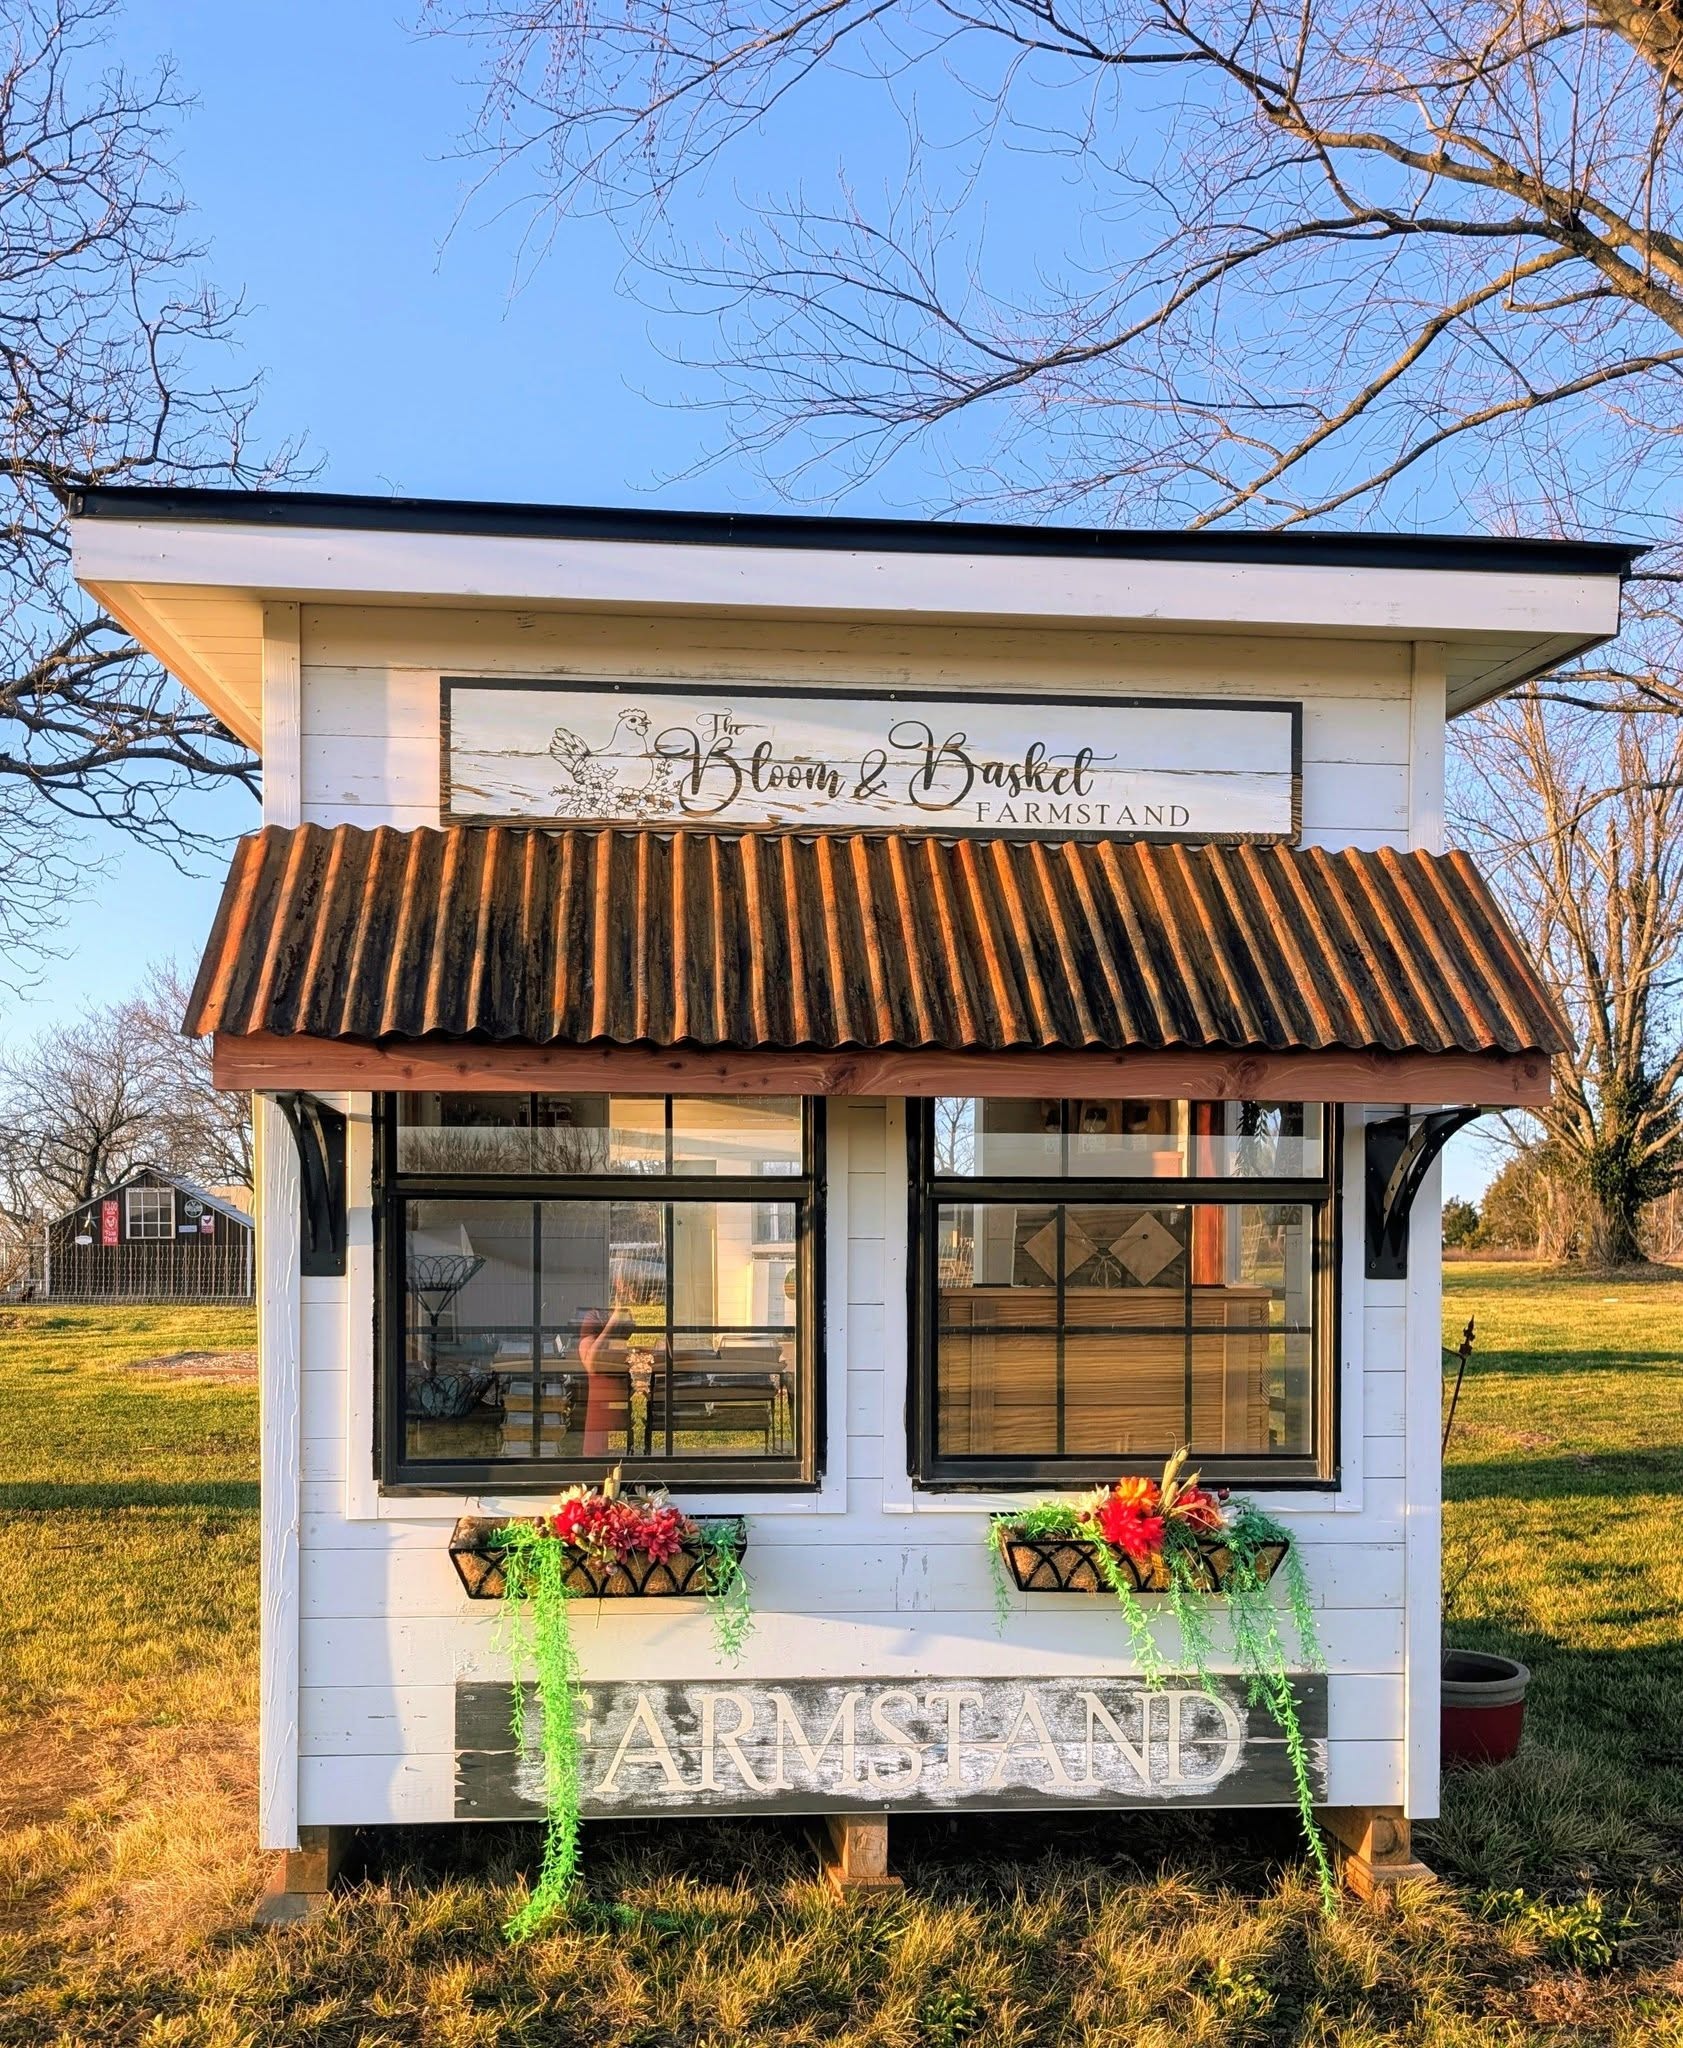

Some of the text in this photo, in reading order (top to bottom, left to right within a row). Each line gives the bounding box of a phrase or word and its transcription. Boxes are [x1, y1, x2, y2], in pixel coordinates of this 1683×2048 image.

[695, 708, 758, 742] The
[653, 720, 1118, 814] Bloom & Basket
[975, 801, 1191, 828] FARMSTAND
